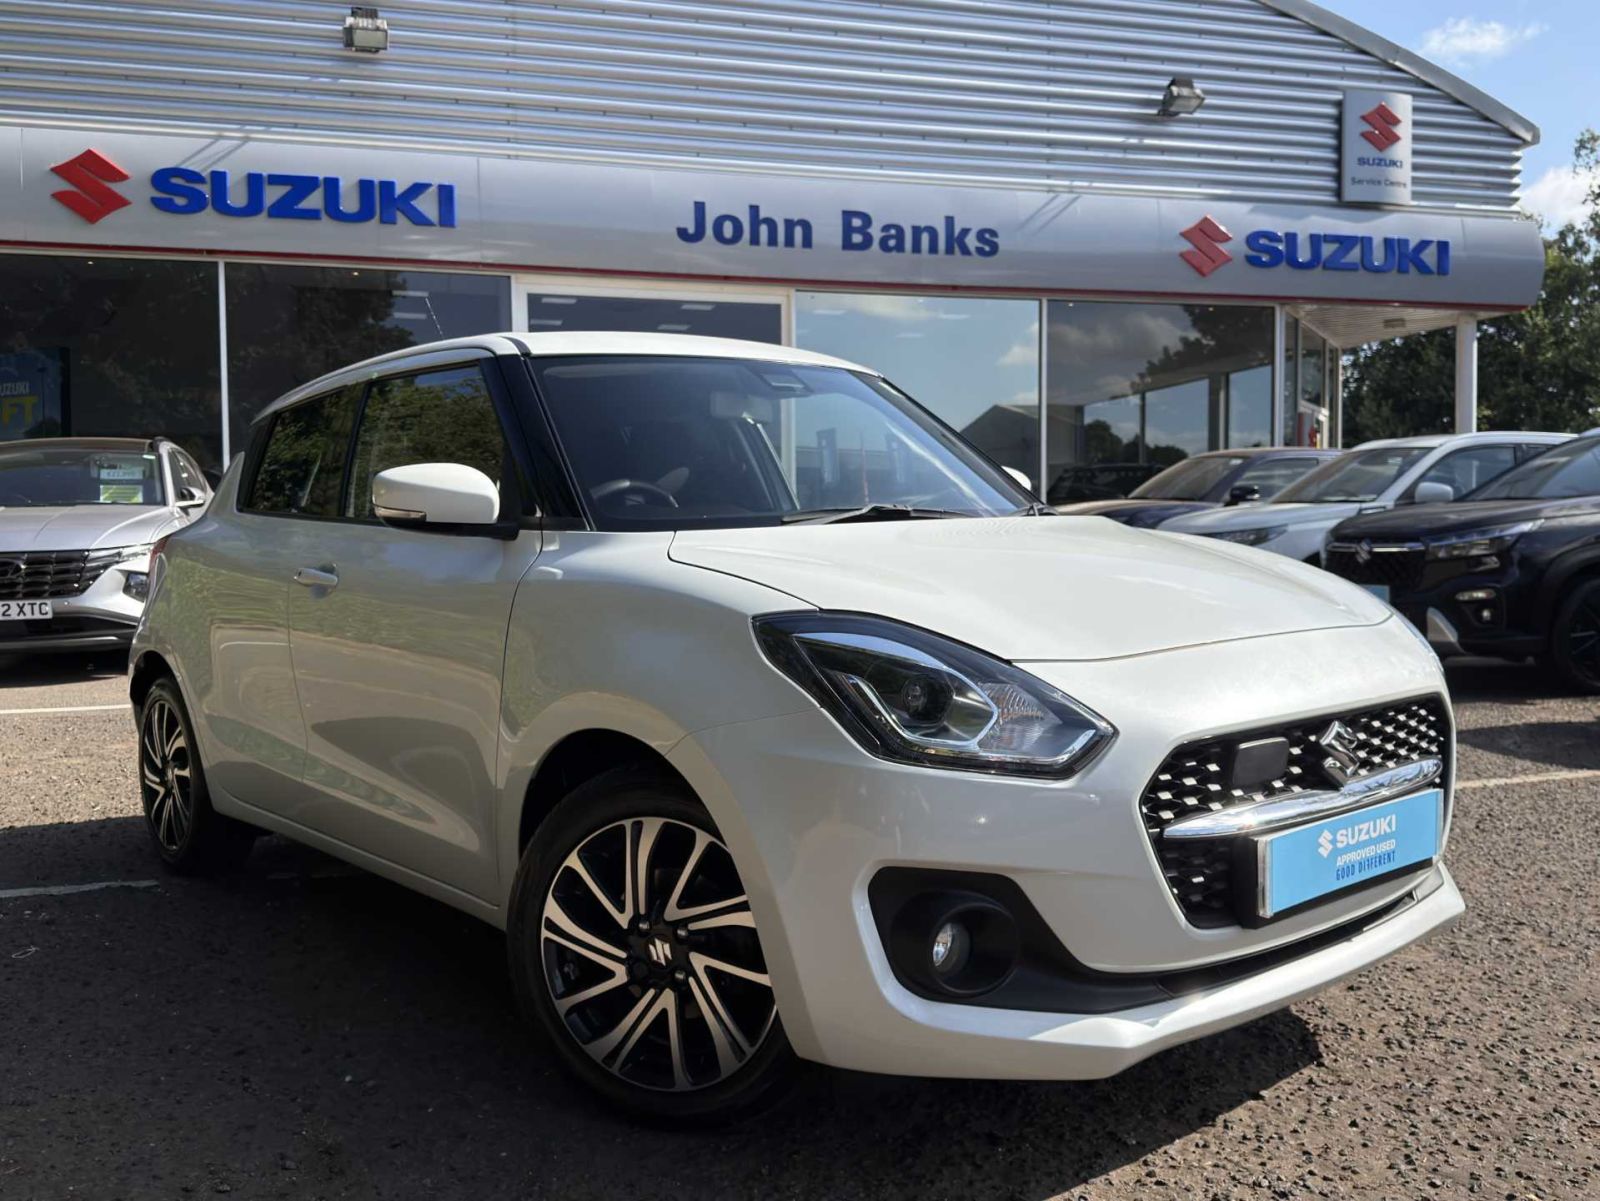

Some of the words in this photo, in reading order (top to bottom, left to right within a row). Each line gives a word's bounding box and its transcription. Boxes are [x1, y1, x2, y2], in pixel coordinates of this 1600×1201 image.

[1357, 156, 1403, 169] SUZUKI
[1350, 176, 1382, 186] Service
[150, 167, 456, 228] SUZUKI
[676, 200, 813, 250] John
[841, 210, 1000, 258] Banks
[1245, 230, 1450, 276] SUZUKI
[1, 603, 11, 617] 2
[16, 602, 49, 616] XTC
[1335, 814, 1396, 848] SUZUKI
[1336, 846, 1376, 867] APPROVED
[1376, 839, 1396, 854] USED
[1336, 864, 1356, 880] GOOD
[1358, 850, 1396, 874] DIFFERENT
